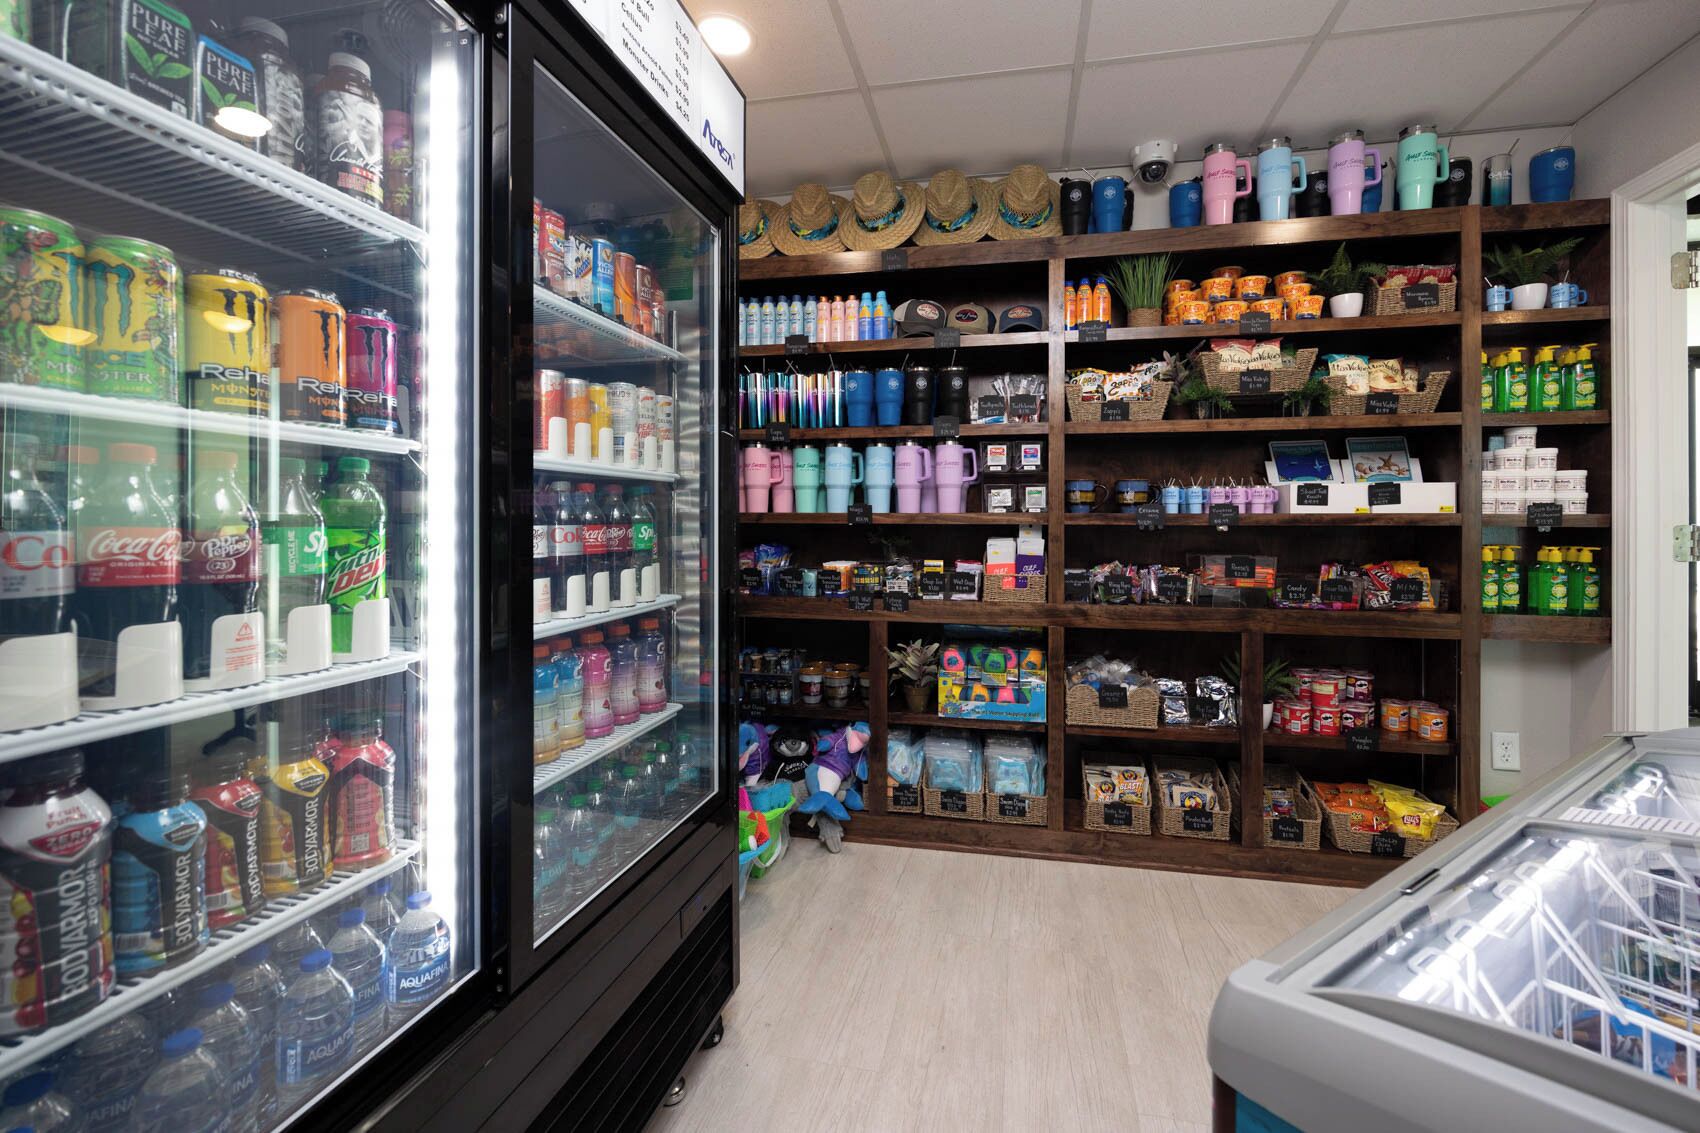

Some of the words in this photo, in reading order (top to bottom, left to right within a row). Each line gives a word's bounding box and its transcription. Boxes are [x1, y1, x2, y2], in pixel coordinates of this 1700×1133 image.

[132, 2, 185, 40] PURE
[132, 19, 186, 52] LEAF
[207, 51, 252, 84] PURE
[207, 63, 251, 97] LEAF
[622, 37, 649, 74] Monster
[650, 71, 669, 98] Drinks
[206, 538, 249, 559] Pepper
[329, 547, 380, 578] Mtn
[1286, 583, 1308, 593] Candy
[1120, 781, 1142, 790] BLAST!
[303, 797, 318, 877] BODYARMOR
[1403, 815, 1420, 826] Lay's
[245, 816, 261, 901] BODYARMOR
[175, 852, 193, 947] BODYARMOR
[59, 863, 90, 998] BODYARMOR
[400, 963, 449, 990] AQUAFINA
